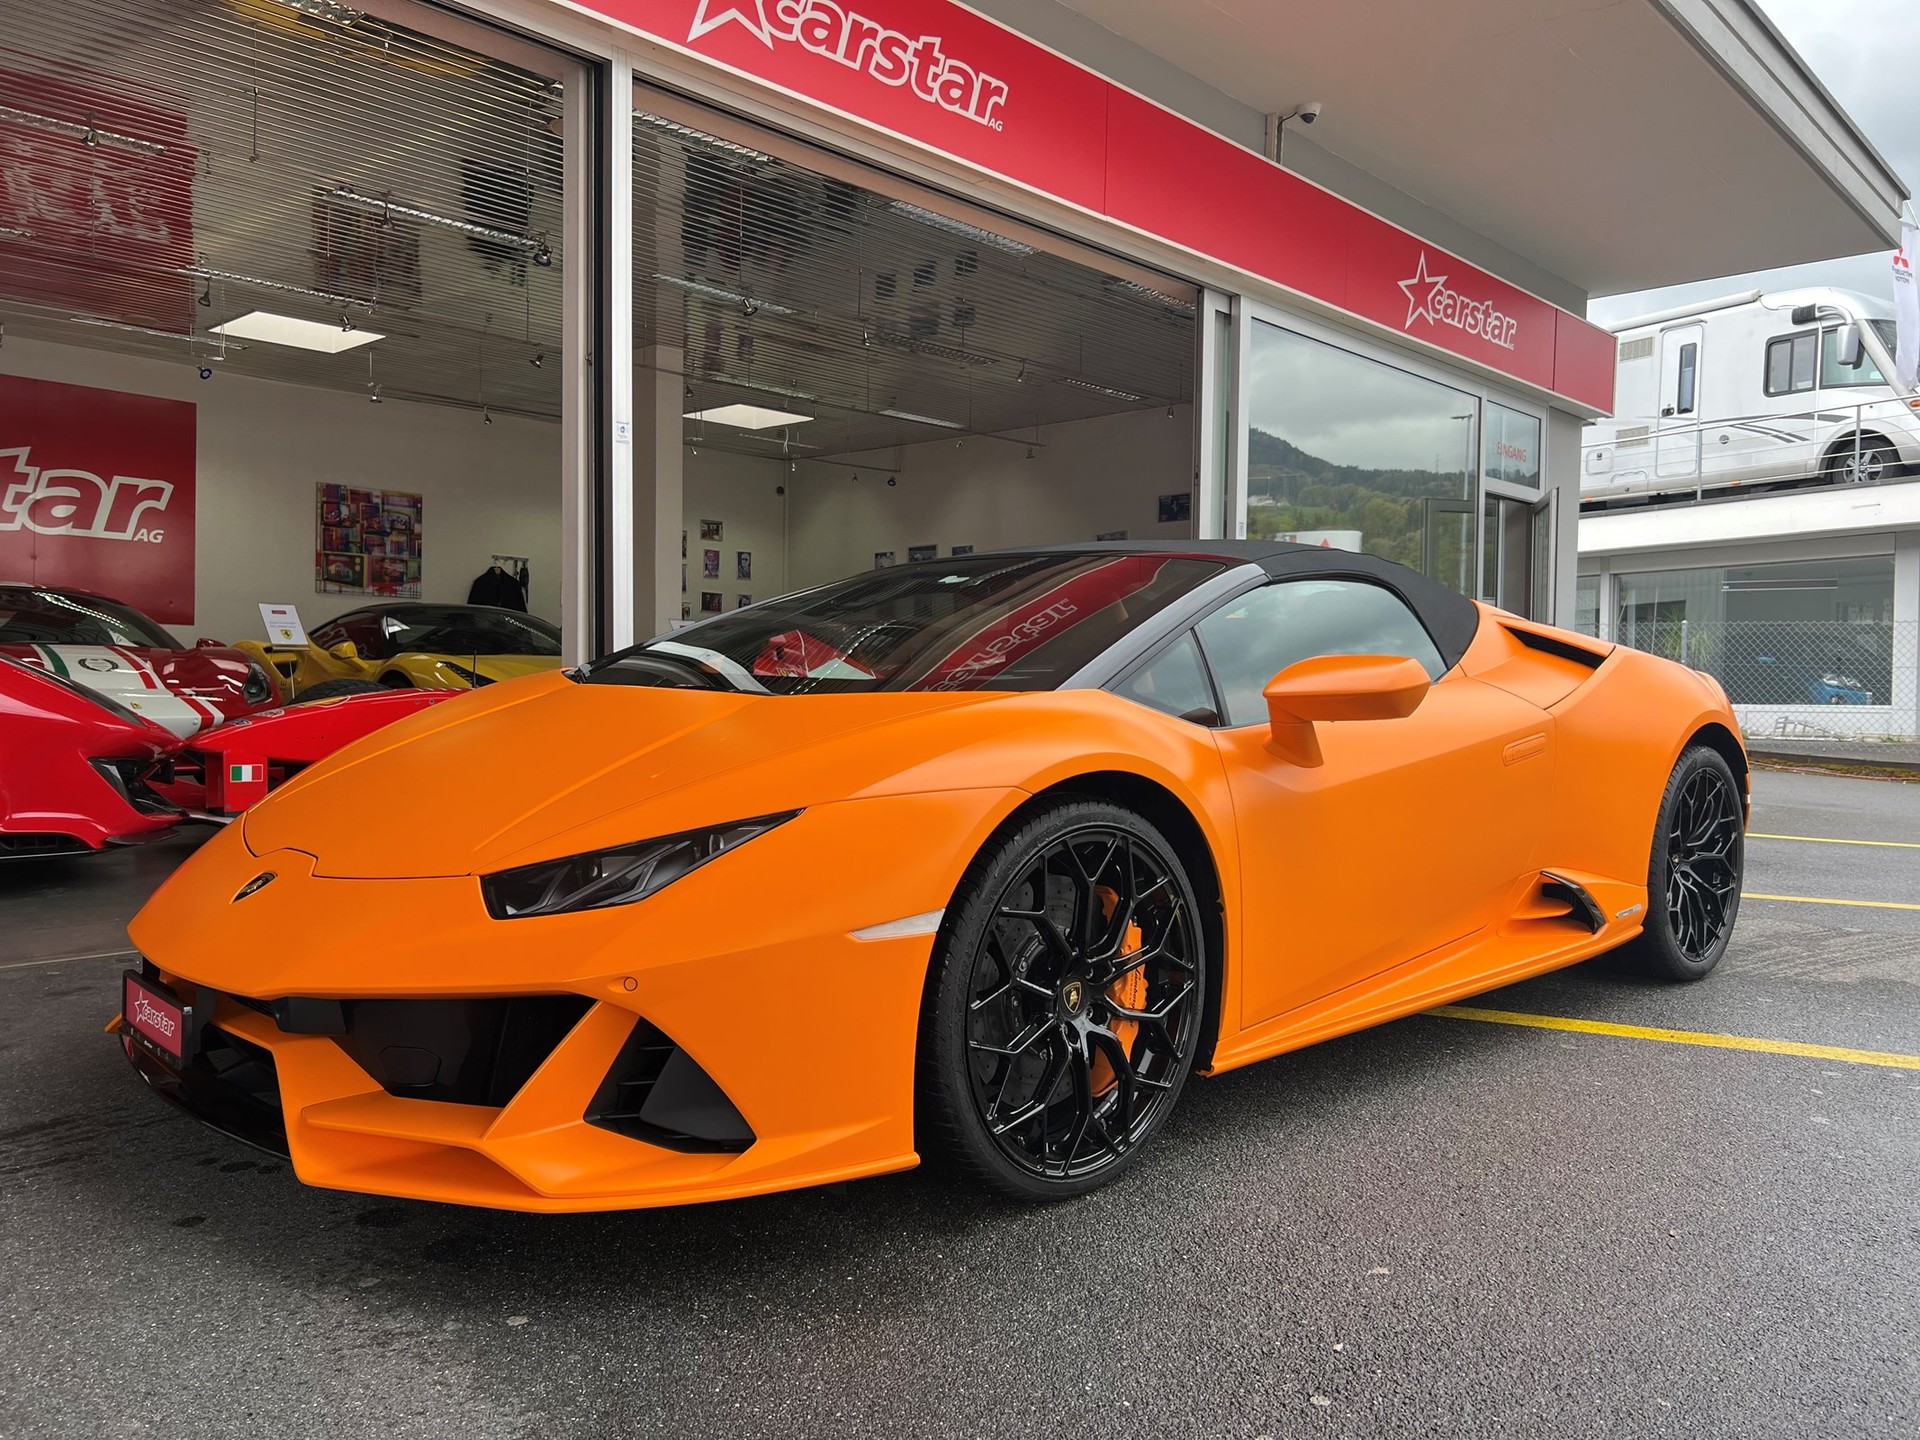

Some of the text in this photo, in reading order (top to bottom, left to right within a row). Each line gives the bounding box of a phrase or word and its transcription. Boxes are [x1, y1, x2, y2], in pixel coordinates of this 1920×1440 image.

[756, 0, 1009, 132] carstar AG
[1428, 285, 1517, 348] carstar
[1497, 441, 1527, 463] EINGANG
[133, 528, 165, 544] AG
[143, 1006, 175, 1036] carstar
